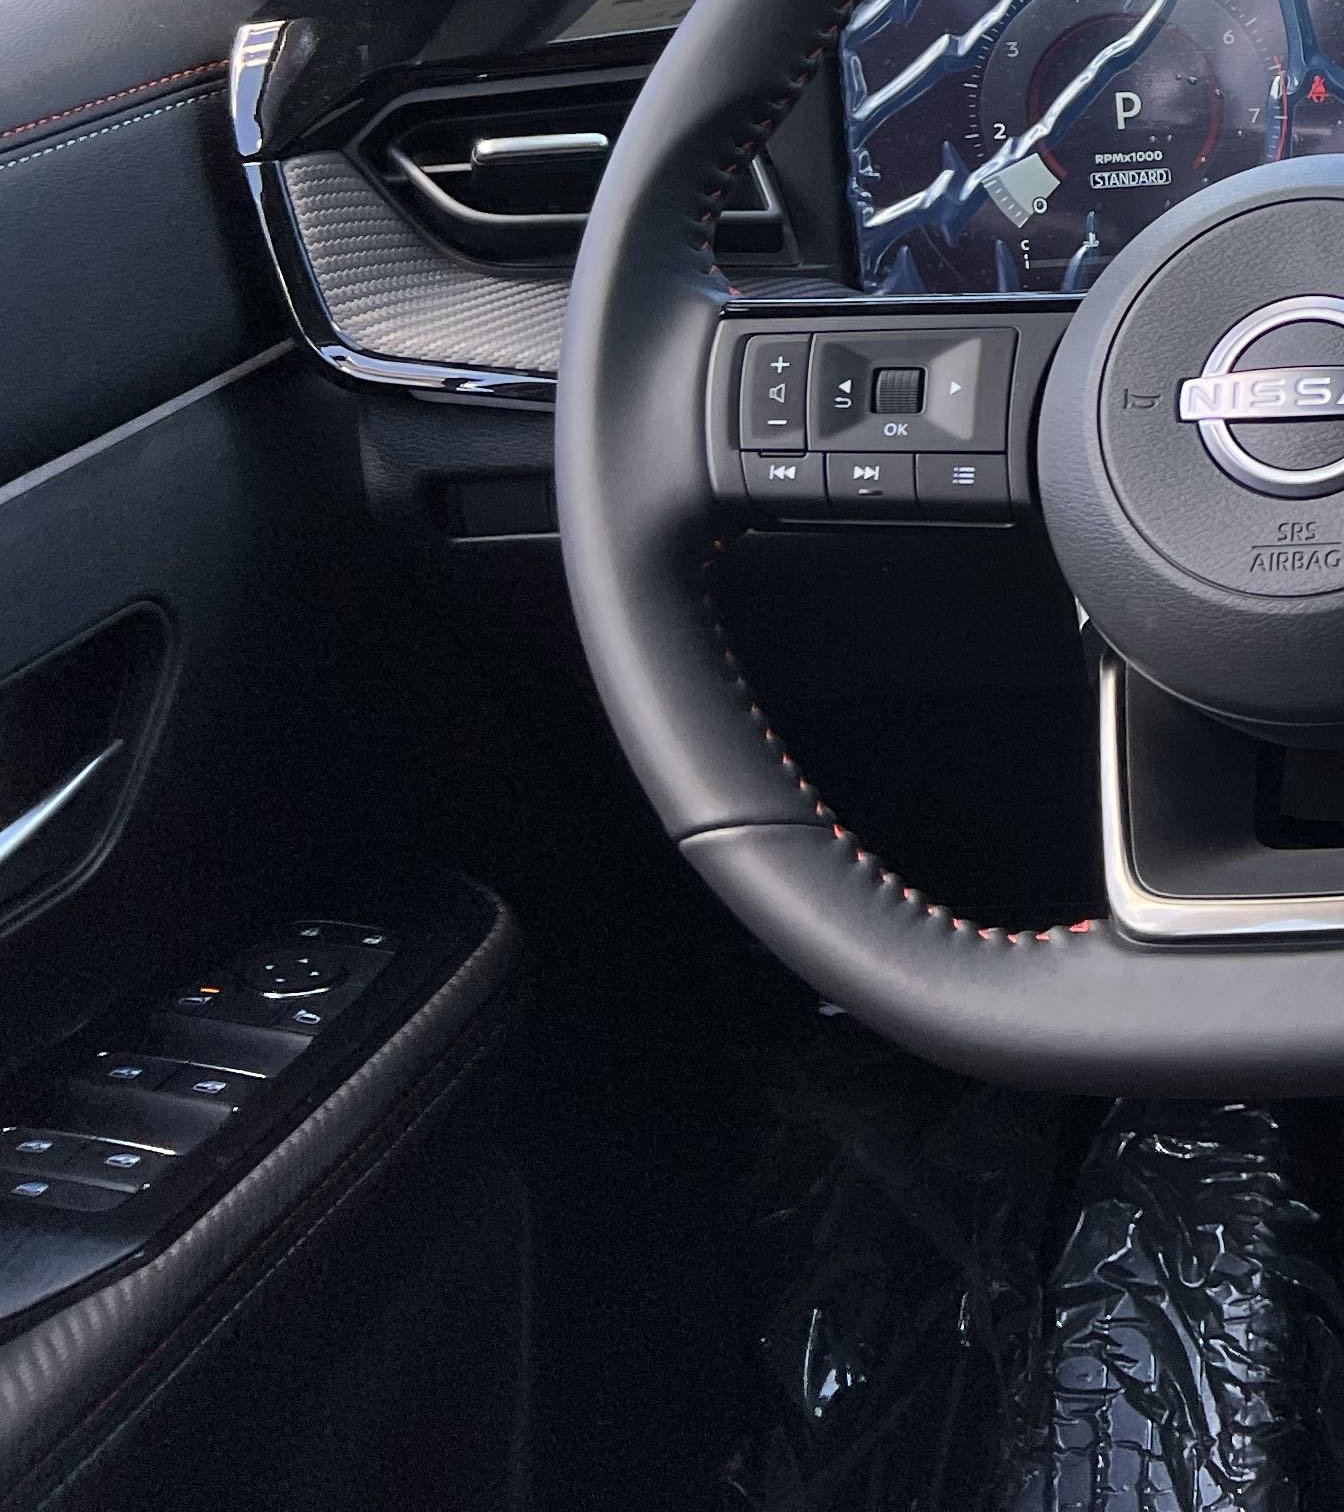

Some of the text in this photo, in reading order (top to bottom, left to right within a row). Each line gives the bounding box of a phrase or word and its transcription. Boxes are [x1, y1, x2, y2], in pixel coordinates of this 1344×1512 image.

[1223, 29, 1235, 45] 6
[1006, 41, 1020, 59] 3
[1114, 91, 1143, 130] P
[1249, 108, 1261, 122] 7
[993, 123, 1007, 139] 2
[1094, 150, 1164, 165] RPMx1000
[1093, 170, 1168, 186] STANDARD
[1032, 196, 1048, 214] 0
[884, 423, 908, 437] OK
[1277, 520, 1319, 543] SRS
[1249, 549, 1343, 573] AIRBAG
